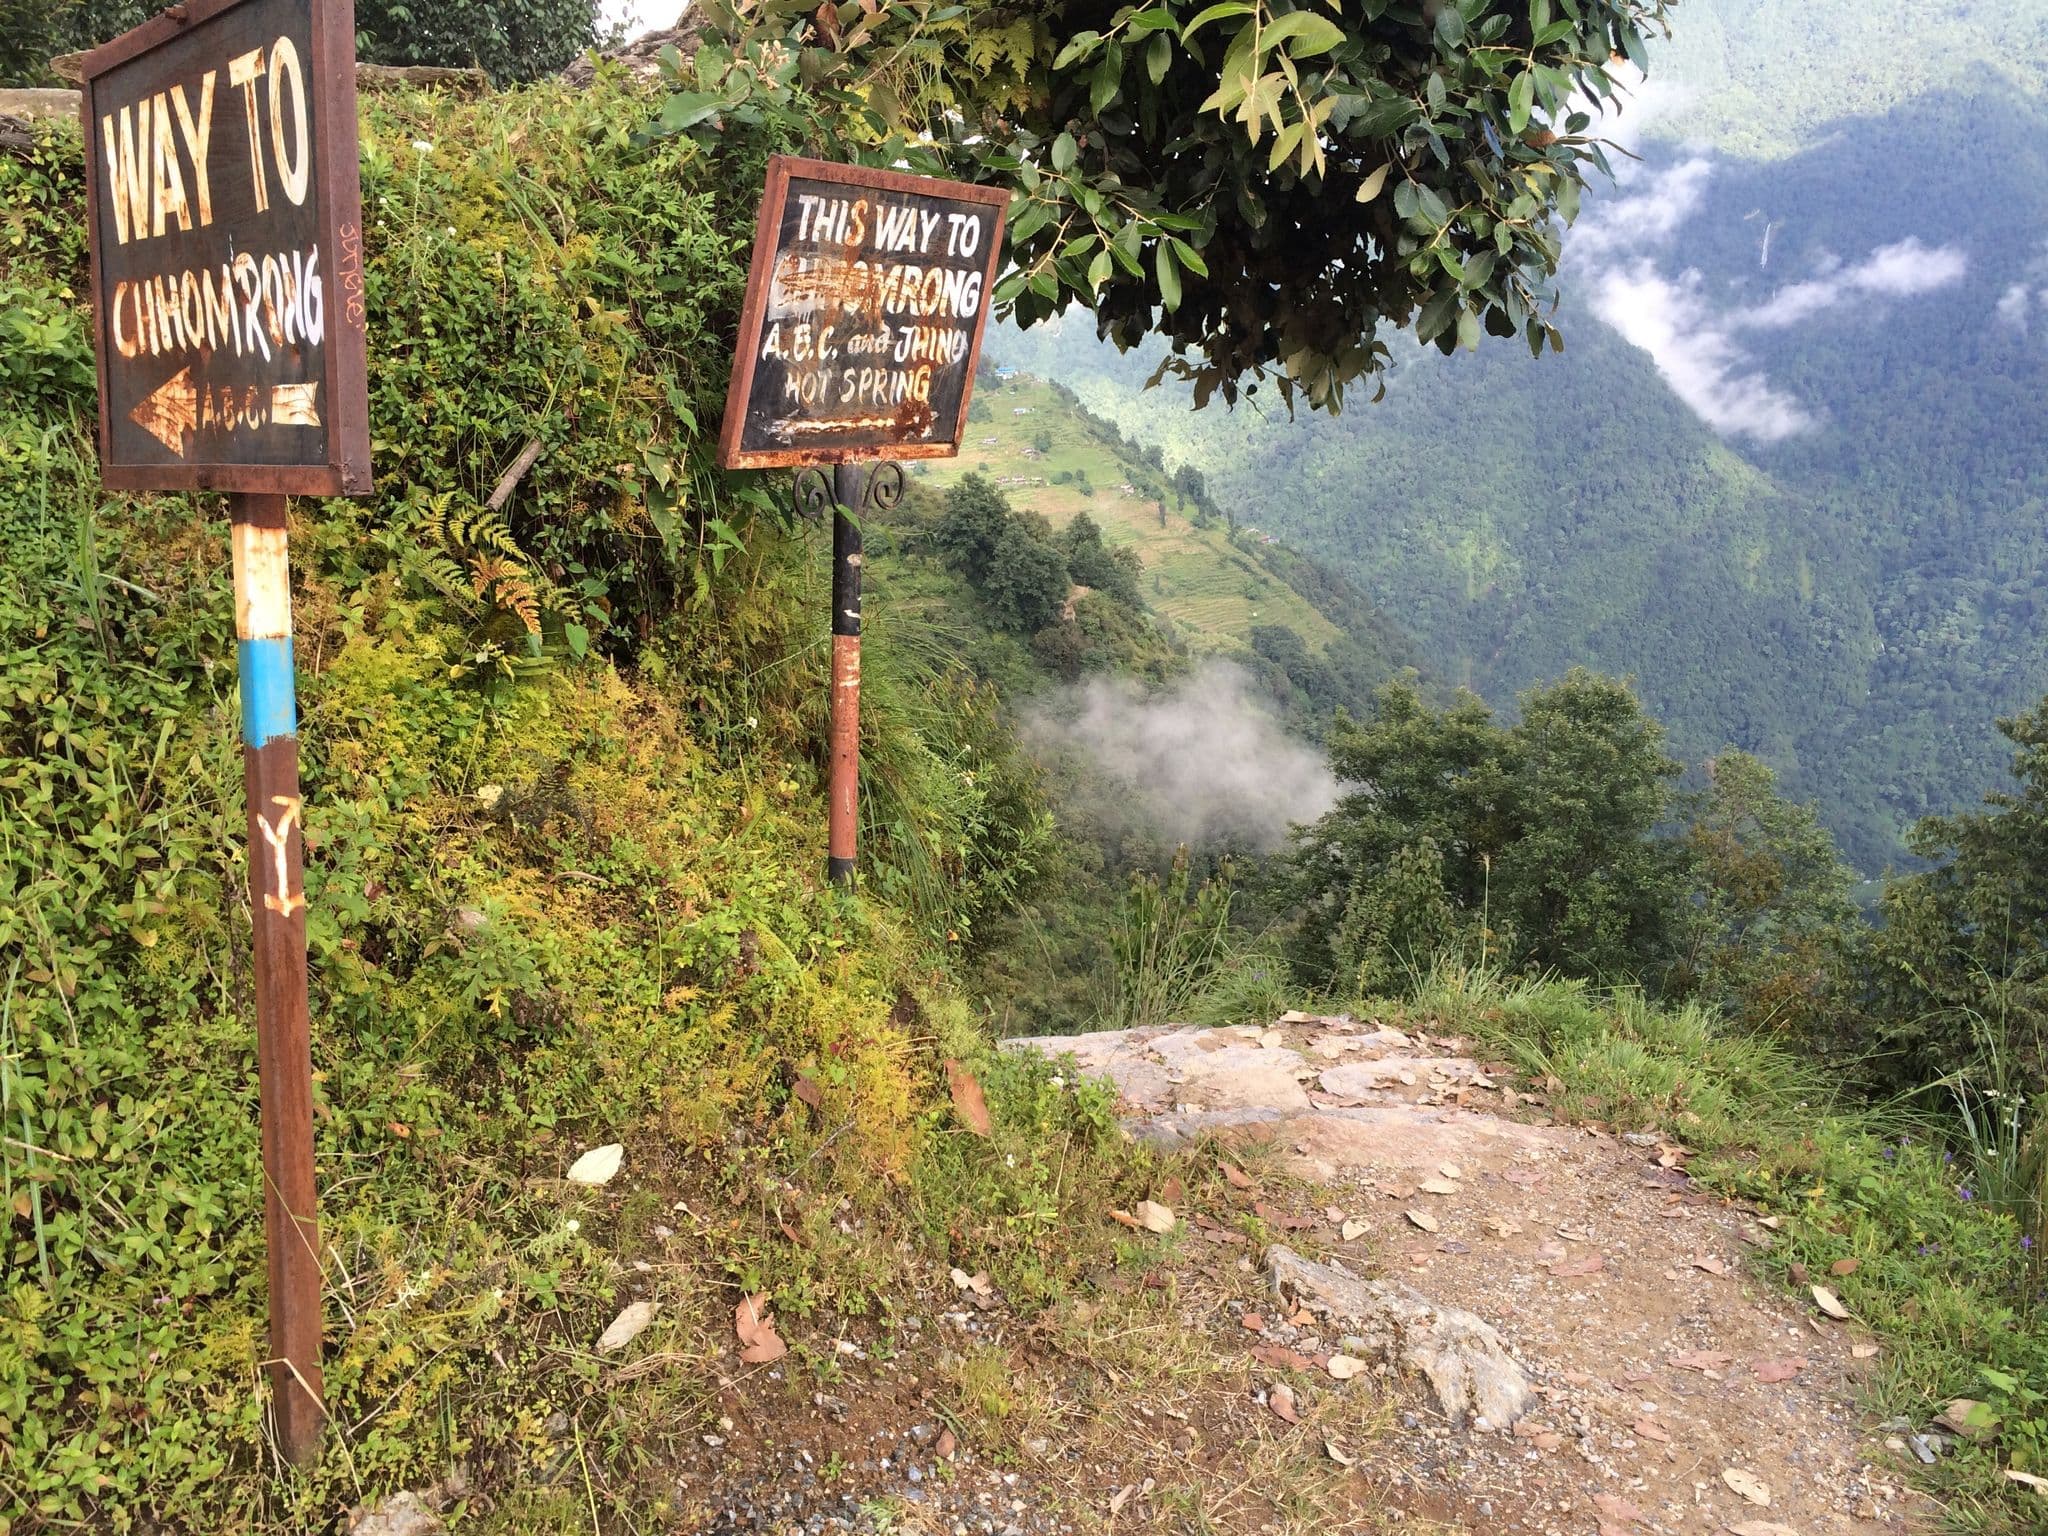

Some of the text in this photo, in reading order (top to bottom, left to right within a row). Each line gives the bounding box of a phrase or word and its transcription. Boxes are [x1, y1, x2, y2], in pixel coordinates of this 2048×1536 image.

[102, 36, 309, 246] WAY TO
[799, 194, 981, 258] THIS WAY TO
[112, 243, 325, 363] CHHOMRONG
[847, 320, 891, 355] and
[785, 364, 932, 407] HOT SPRING
